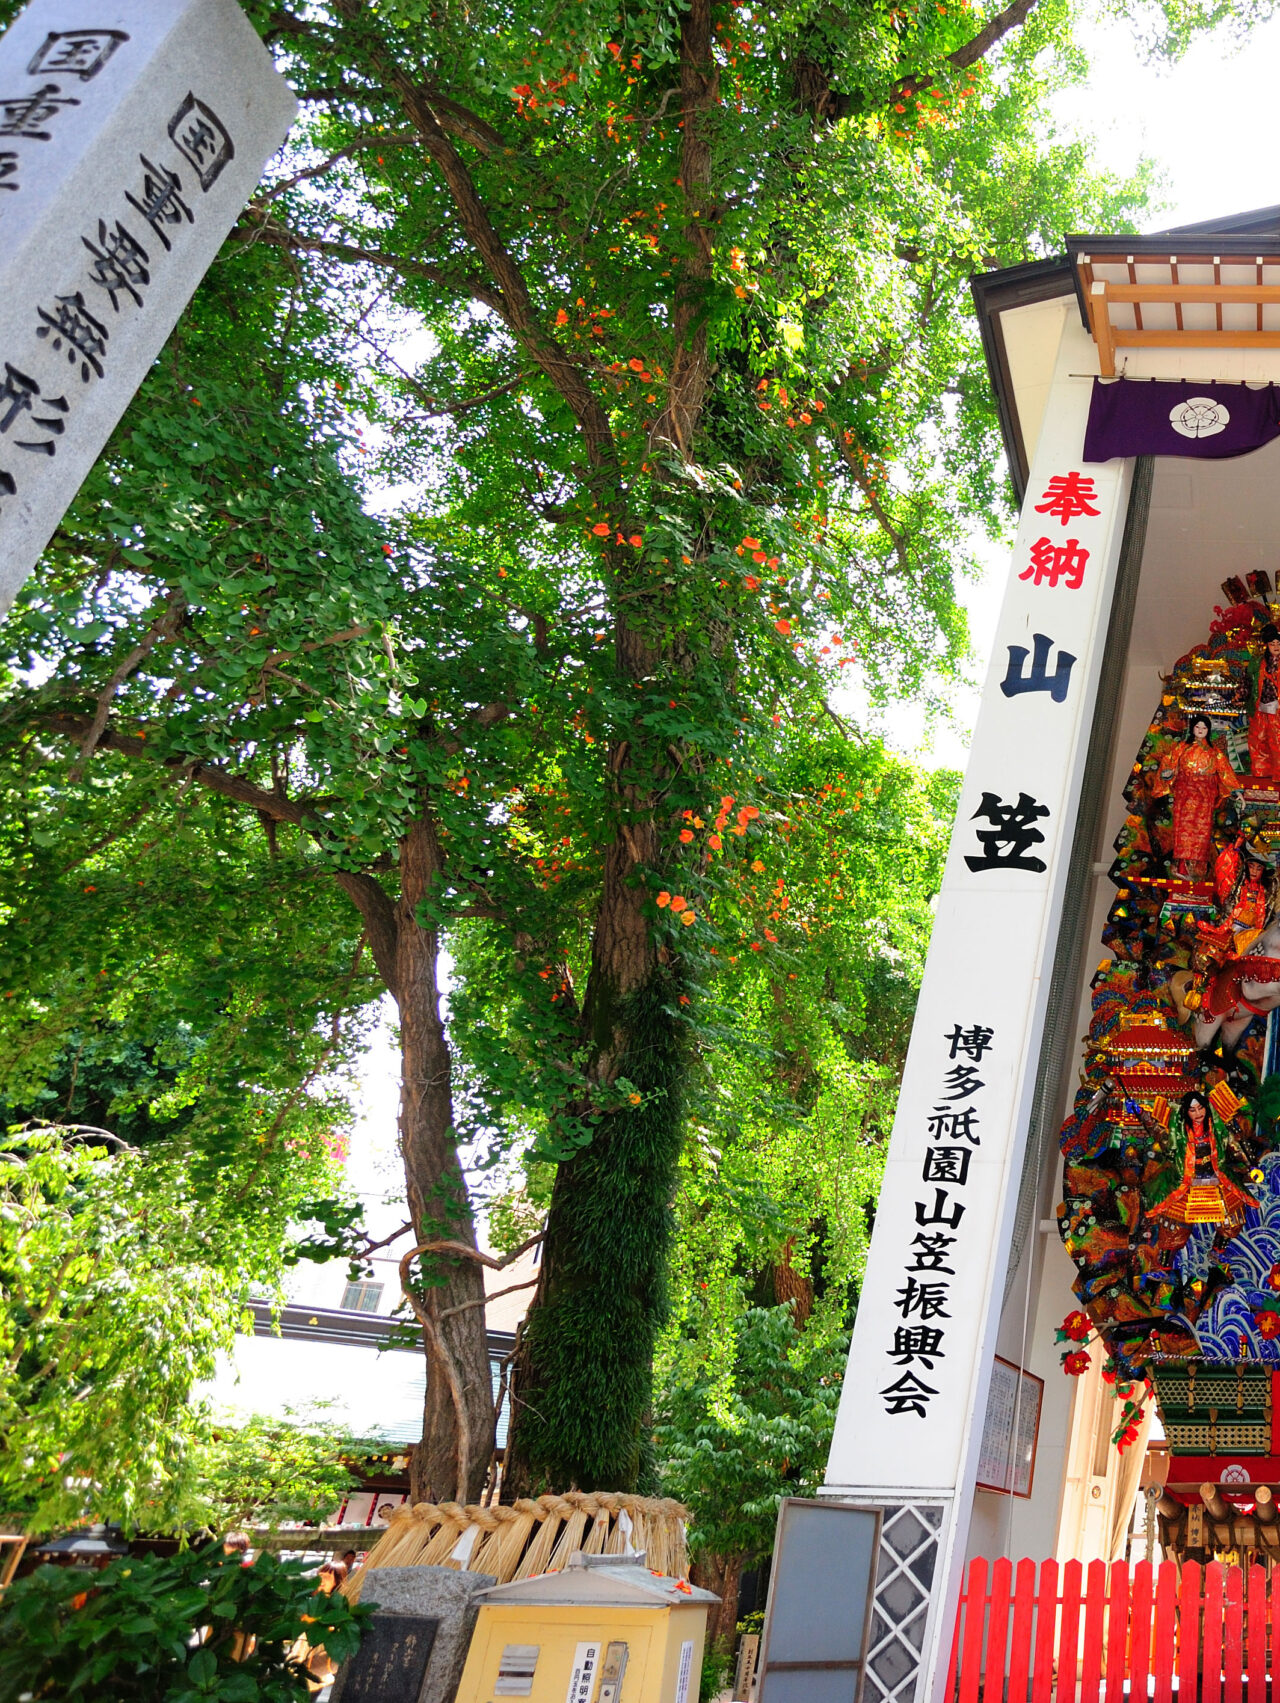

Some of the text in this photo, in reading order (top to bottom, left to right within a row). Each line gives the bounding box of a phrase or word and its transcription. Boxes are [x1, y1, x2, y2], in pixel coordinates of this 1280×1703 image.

[1018, 472, 1101, 590] 奉納
[878, 1024, 994, 1418] 博多祇園山笠振興会
